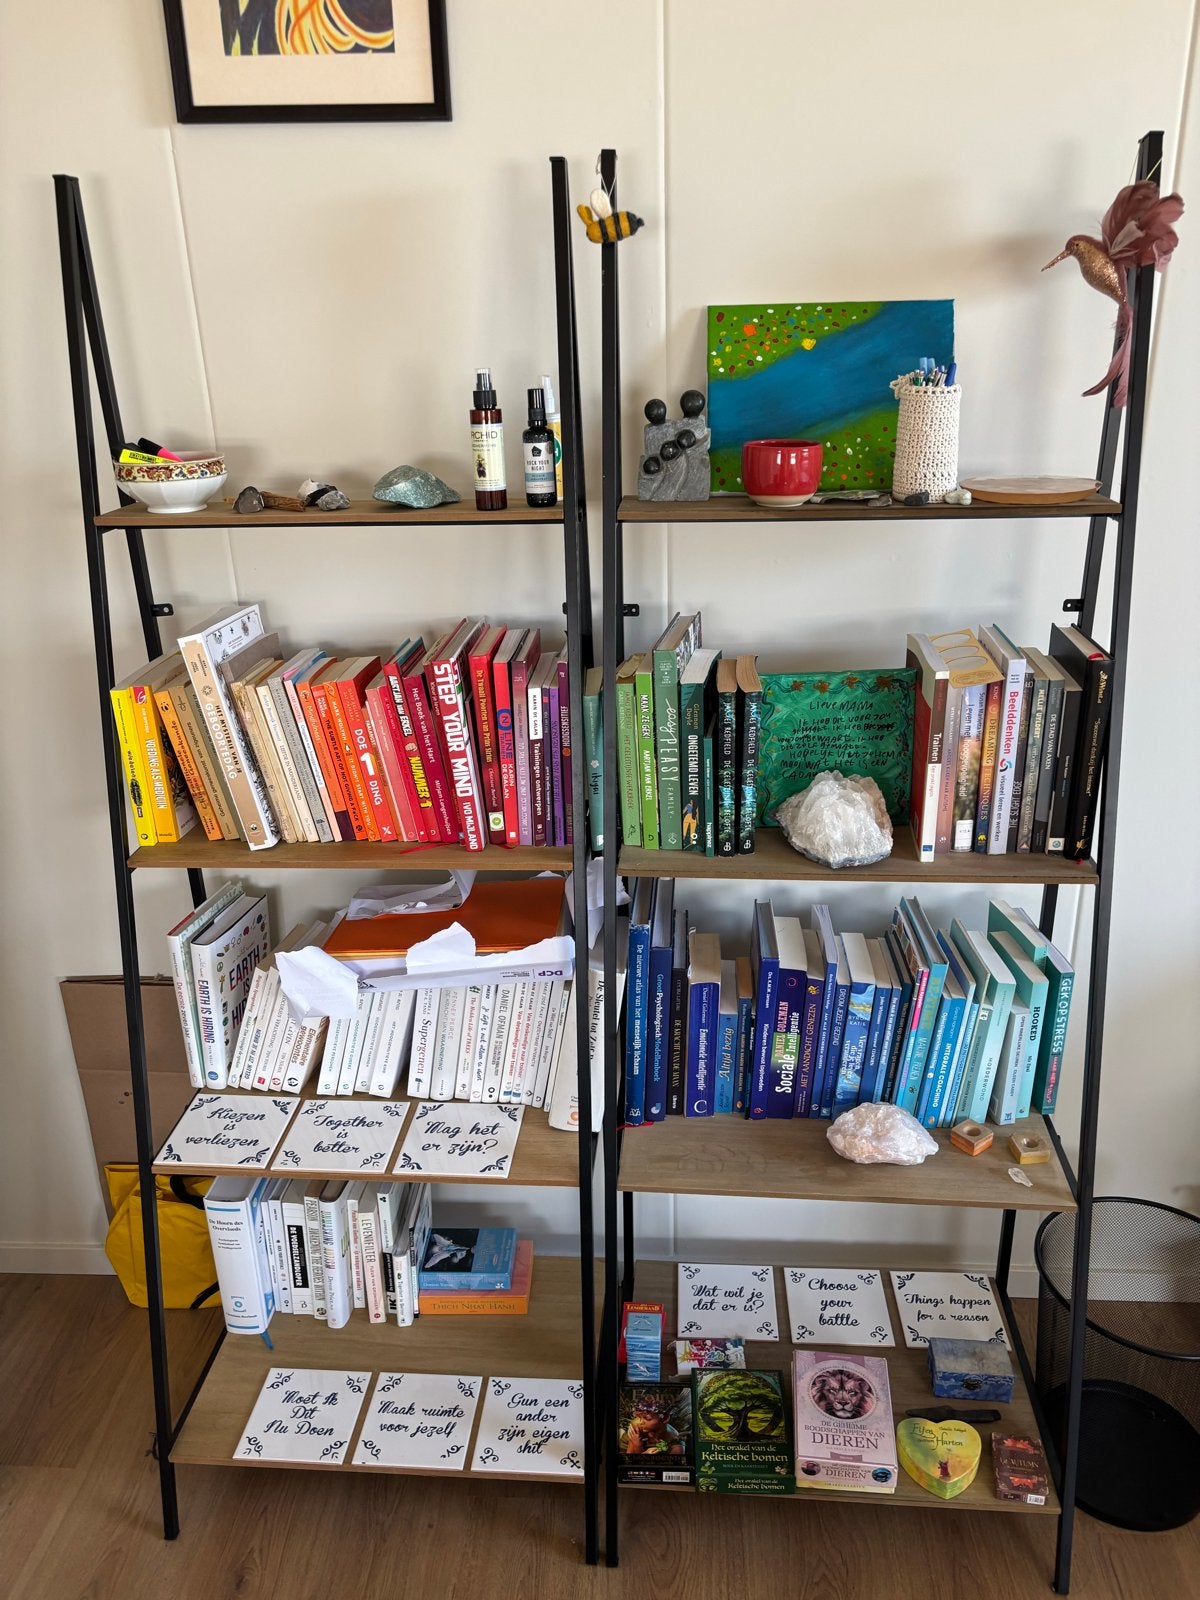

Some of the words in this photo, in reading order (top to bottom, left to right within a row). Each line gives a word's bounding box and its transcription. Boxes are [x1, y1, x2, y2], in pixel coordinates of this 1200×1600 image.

[471, 431, 498, 440] RCHID
[411, 687, 421, 700] Het
[433, 663, 456, 705] STEP
[414, 701, 425, 719] Boek
[964, 704, 975, 724] Leven
[419, 720, 428, 734] van
[442, 711, 464, 752] YOUR
[560, 705, 570, 746] HOOGSENSITIEF
[962, 726, 973, 738] met
[1003, 691, 1019, 754] Beelddenken
[205, 703, 235, 779] GEBOORTEDAG
[354, 728, 367, 750] DOE
[422, 734, 431, 746] het
[930, 732, 941, 761] Trainen
[985, 718, 996, 764] DREAMING
[144, 738, 159, 766] VOEDING
[425, 747, 435, 763] Hart
[532, 743, 542, 778] Trainingen
[660, 737, 678, 781] PEASY
[687, 735, 698, 772] ONGETEMD
[149, 767, 162, 779] ALS
[450, 756, 473, 797] MIND
[957, 739, 972, 796] hooggevoeligheid
[408, 754, 429, 799] NUMMER
[420, 799, 432, 809] 1
[589, 772, 602, 794] ikigai
[688, 774, 698, 795] LEVEN
[152, 780, 168, 809] MEDICIJN
[368, 780, 382, 805] DING
[533, 780, 543, 815] ontwerpen
[980, 767, 992, 820] TECHNIQUES
[462, 801, 471, 814] IVO
[464, 815, 478, 849] MIJLAND
[636, 944, 643, 952] De
[229, 945, 260, 991] EARTH
[635, 954, 643, 977] nieuwe
[197, 978, 210, 1004] EARTH
[634, 979, 642, 993] atlas
[1060, 977, 1071, 1000] GEK
[498, 989, 510, 1014] DANIEL
[837, 988, 846, 1007] DROOM
[200, 1005, 211, 1013] IS
[805, 1003, 816, 1034] GENEZEN
[834, 1007, 843, 1025] JEZELF
[1058, 1002, 1067, 1016] OP
[201, 1017, 214, 1044] HIRING
[494, 1015, 506, 1039] OFMAN
[652, 974, 663, 1081] GrootPsychologischModellenboek
[1029, 1006, 1039, 1040] HOOKED
[291, 1025, 307, 1064] gewoontes
[633, 1019, 641, 1049] menselijk
[697, 1028, 708, 1057] Emotionele
[722, 1027, 734, 1049] bezig
[761, 1023, 769, 1045] Kinderen
[832, 1025, 841, 1045] GEZOND
[1053, 1018, 1065, 1054] STRESS
[299, 1028, 317, 1067] Elementaire
[415, 1018, 431, 1074] Supergenen
[759, 1046, 767, 1063] bewust
[774, 1054, 794, 1093] Sociale
[785, 1012, 799, 1052] Intelligentie
[801, 1036, 812, 1072] AANDACHT
[632, 1051, 640, 1074] lichaam
[719, 1052, 732, 1081] Altijd
[939, 1042, 951, 1074] INTEGRALE
[695, 1059, 706, 1090] intelligentie
[757, 1064, 765, 1091] (op)voeden
[799, 1073, 808, 1087] MET
[932, 1075, 944, 1108] COACHING
[207, 1107, 266, 1123] Kiezen
[313, 1115, 384, 1129] Together
[223, 1121, 236, 1131] is
[336, 1129, 349, 1139] is
[424, 1121, 461, 1137] Mag
[471, 1123, 501, 1135] het
[185, 1132, 260, 1148] verliezen
[313, 1140, 361, 1154] better
[421, 1143, 442, 1153] er
[447, 1139, 498, 1154] zijn?
[305, 1198, 317, 1222] PEARSON
[290, 1234, 302, 1286] VOEDSELZANDLOPER
[691, 1284, 721, 1298] Wat
[724, 1287, 744, 1297] wil
[748, 1287, 764, 1301] je
[808, 1278, 858, 1291] Choose
[692, 1299, 719, 1311] dat
[721, 1303, 737, 1311] er
[744, 1299, 765, 1314] is?
[820, 1299, 854, 1311] your
[904, 1293, 944, 1308] Things
[950, 1294, 992, 1309] happen
[819, 1313, 860, 1327] battle
[916, 1309, 934, 1323] for
[938, 1313, 946, 1321] a
[950, 1313, 990, 1322] reason
[282, 1391, 319, 1405] Moet
[321, 1392, 339, 1406] Ik
[378, 1400, 416, 1416] Maak
[422, 1404, 465, 1418] ruimte
[507, 1393, 540, 1408] Gun
[545, 1398, 570, 1408] een
[291, 1405, 316, 1420] Dit
[516, 1410, 557, 1422] ander
[264, 1421, 289, 1435] Nu
[296, 1422, 335, 1436] Doen
[379, 1422, 410, 1433] voor
[412, 1421, 458, 1438] jezelf
[498, 1426, 527, 1441] zijn
[532, 1427, 571, 1441] eigen
[804, 1425, 866, 1437] BOODSCHAPPEN
[833, 1422, 867, 1430] GEHEIME
[517, 1441, 546, 1455] shit
[812, 1432, 878, 1449] DIEREN
[702, 1452, 749, 1461] Keltische
[752, 1452, 788, 1462] bomen
[826, 1469, 867, 1479] DIEREN
